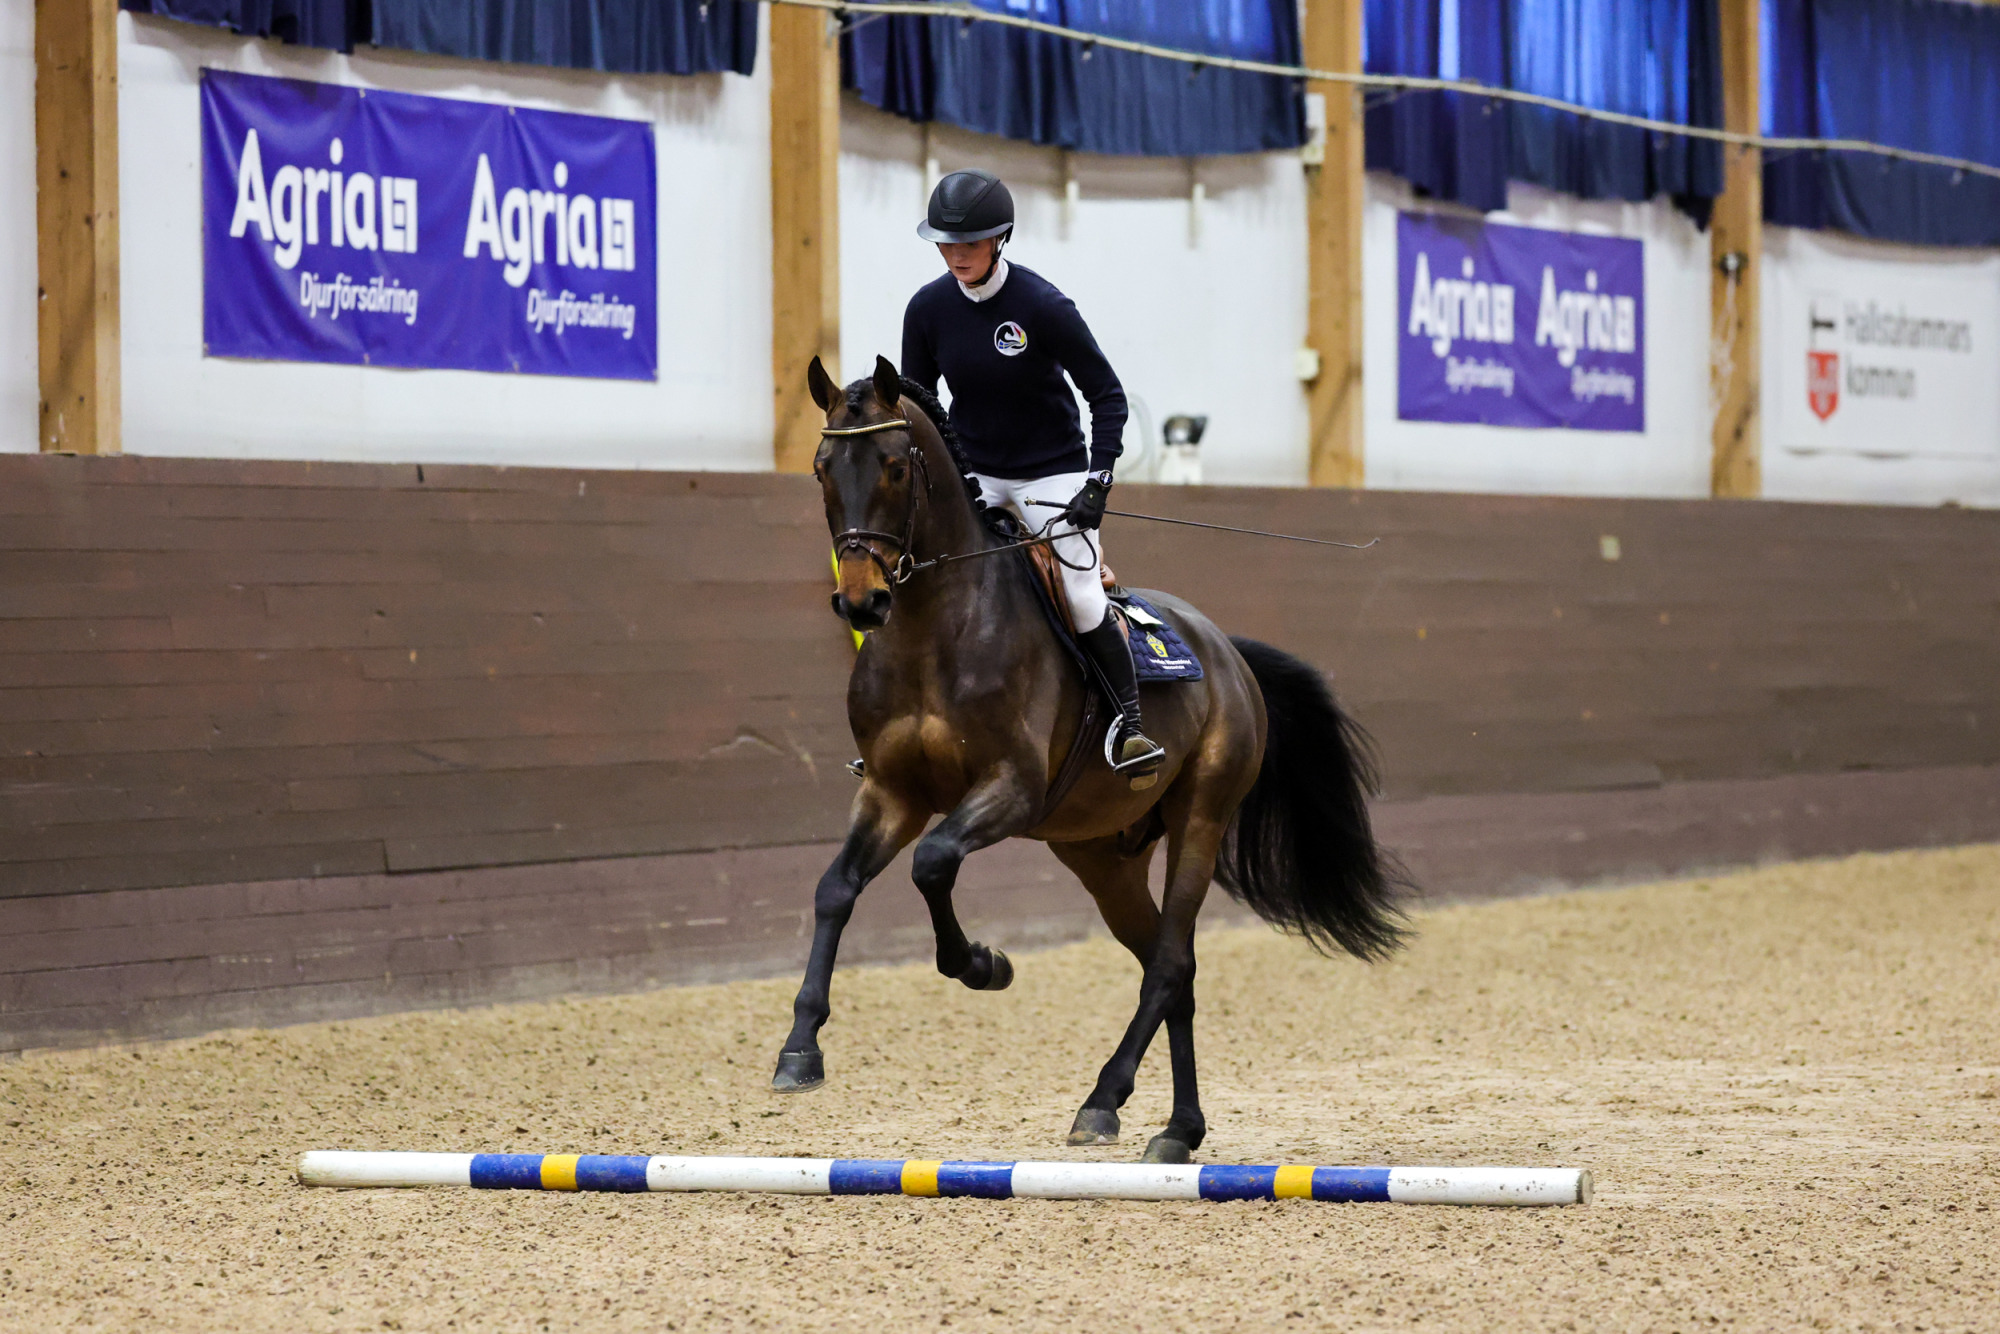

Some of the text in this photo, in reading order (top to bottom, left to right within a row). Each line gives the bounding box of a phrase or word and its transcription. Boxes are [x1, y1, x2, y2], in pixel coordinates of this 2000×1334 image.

[229, 128, 378, 270] Agria
[463, 153, 600, 287] Agria
[300, 271, 418, 326] Djurförsäkring
[526, 288, 636, 340] Djurförsäkring
[1408, 251, 1491, 358] Agria
[1536, 265, 1613, 368] Agria
